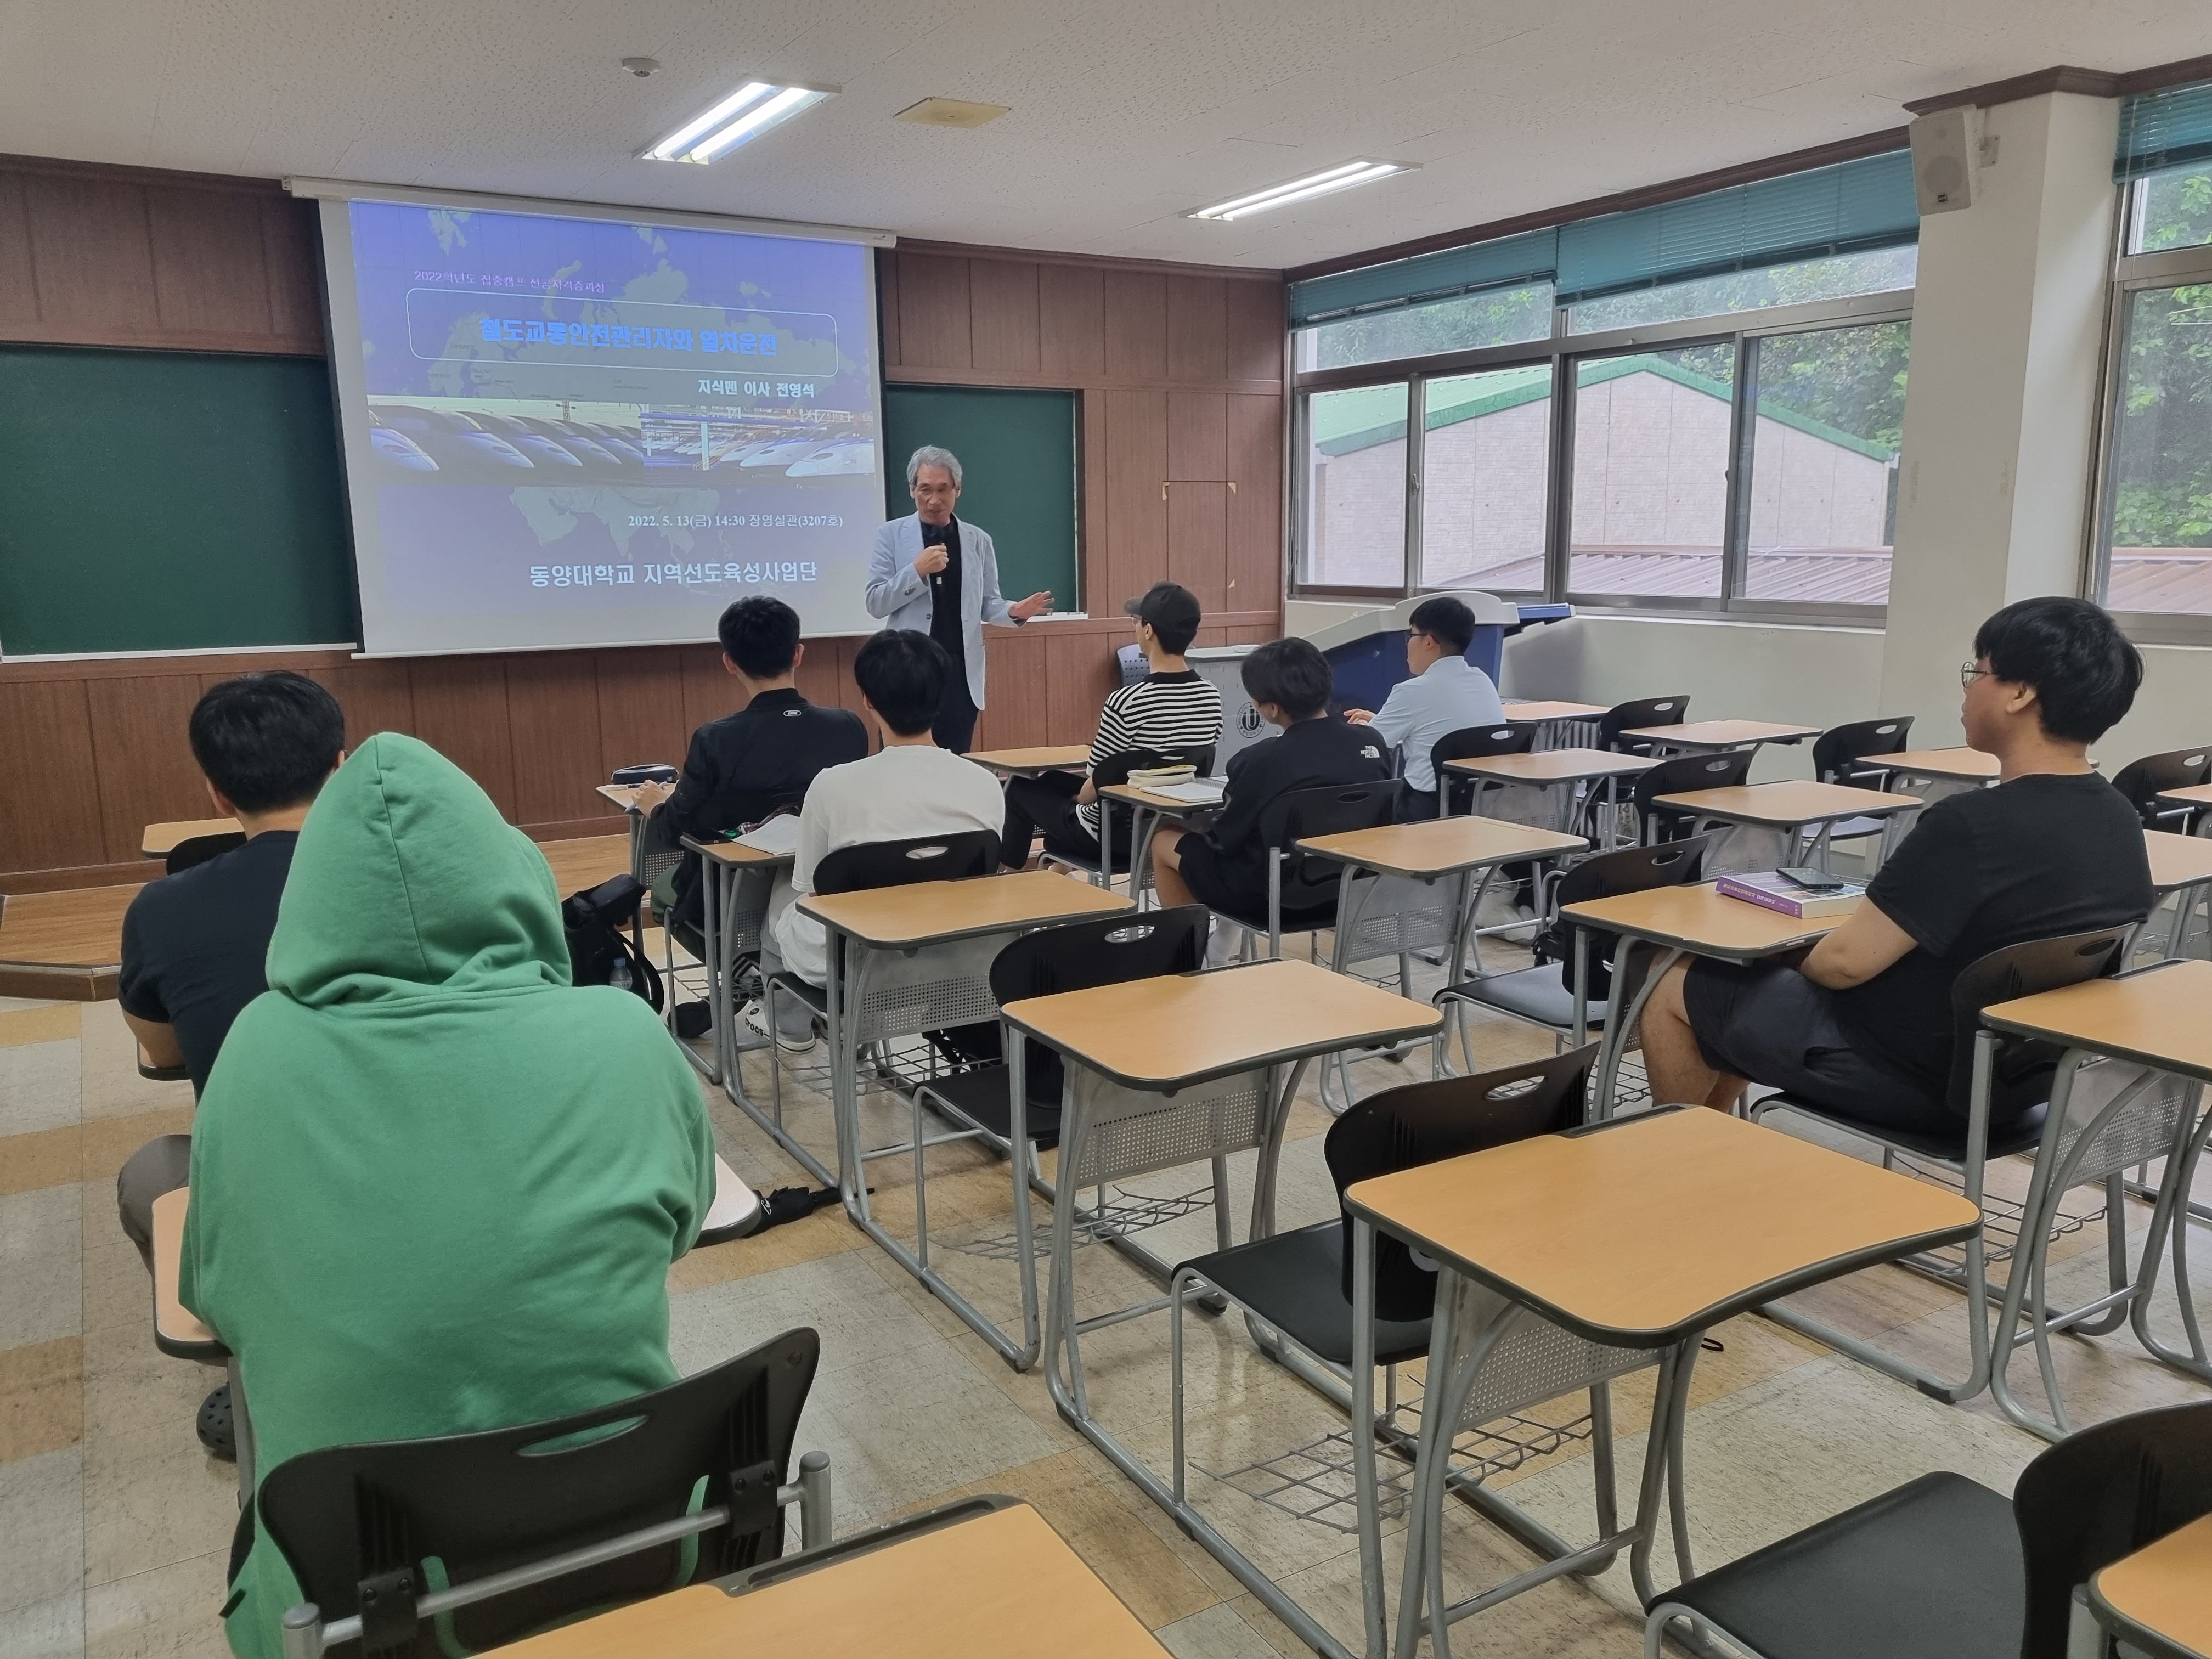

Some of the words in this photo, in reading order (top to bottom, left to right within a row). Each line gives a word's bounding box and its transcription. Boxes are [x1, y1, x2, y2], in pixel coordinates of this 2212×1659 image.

[479, 317, 693, 352] 철도교통안전관리자와
[699, 330, 777, 356] 열차운전
[697, 379, 738, 396] 지식펜
[743, 381, 770, 397] 이사
[776, 383, 815, 398] 전영석
[628, 515, 659, 527] 2022.
[662, 515, 673, 527] 5.
[676, 515, 712, 528] 13(금)
[715, 515, 746, 527] 14:30
[749, 514, 843, 528] 장영실관(3207호)
[529, 563, 635, 588] 동양대학교
[643, 561, 818, 585] 지역선도육성사업단
[745, 1018, 764, 1036] crocs
